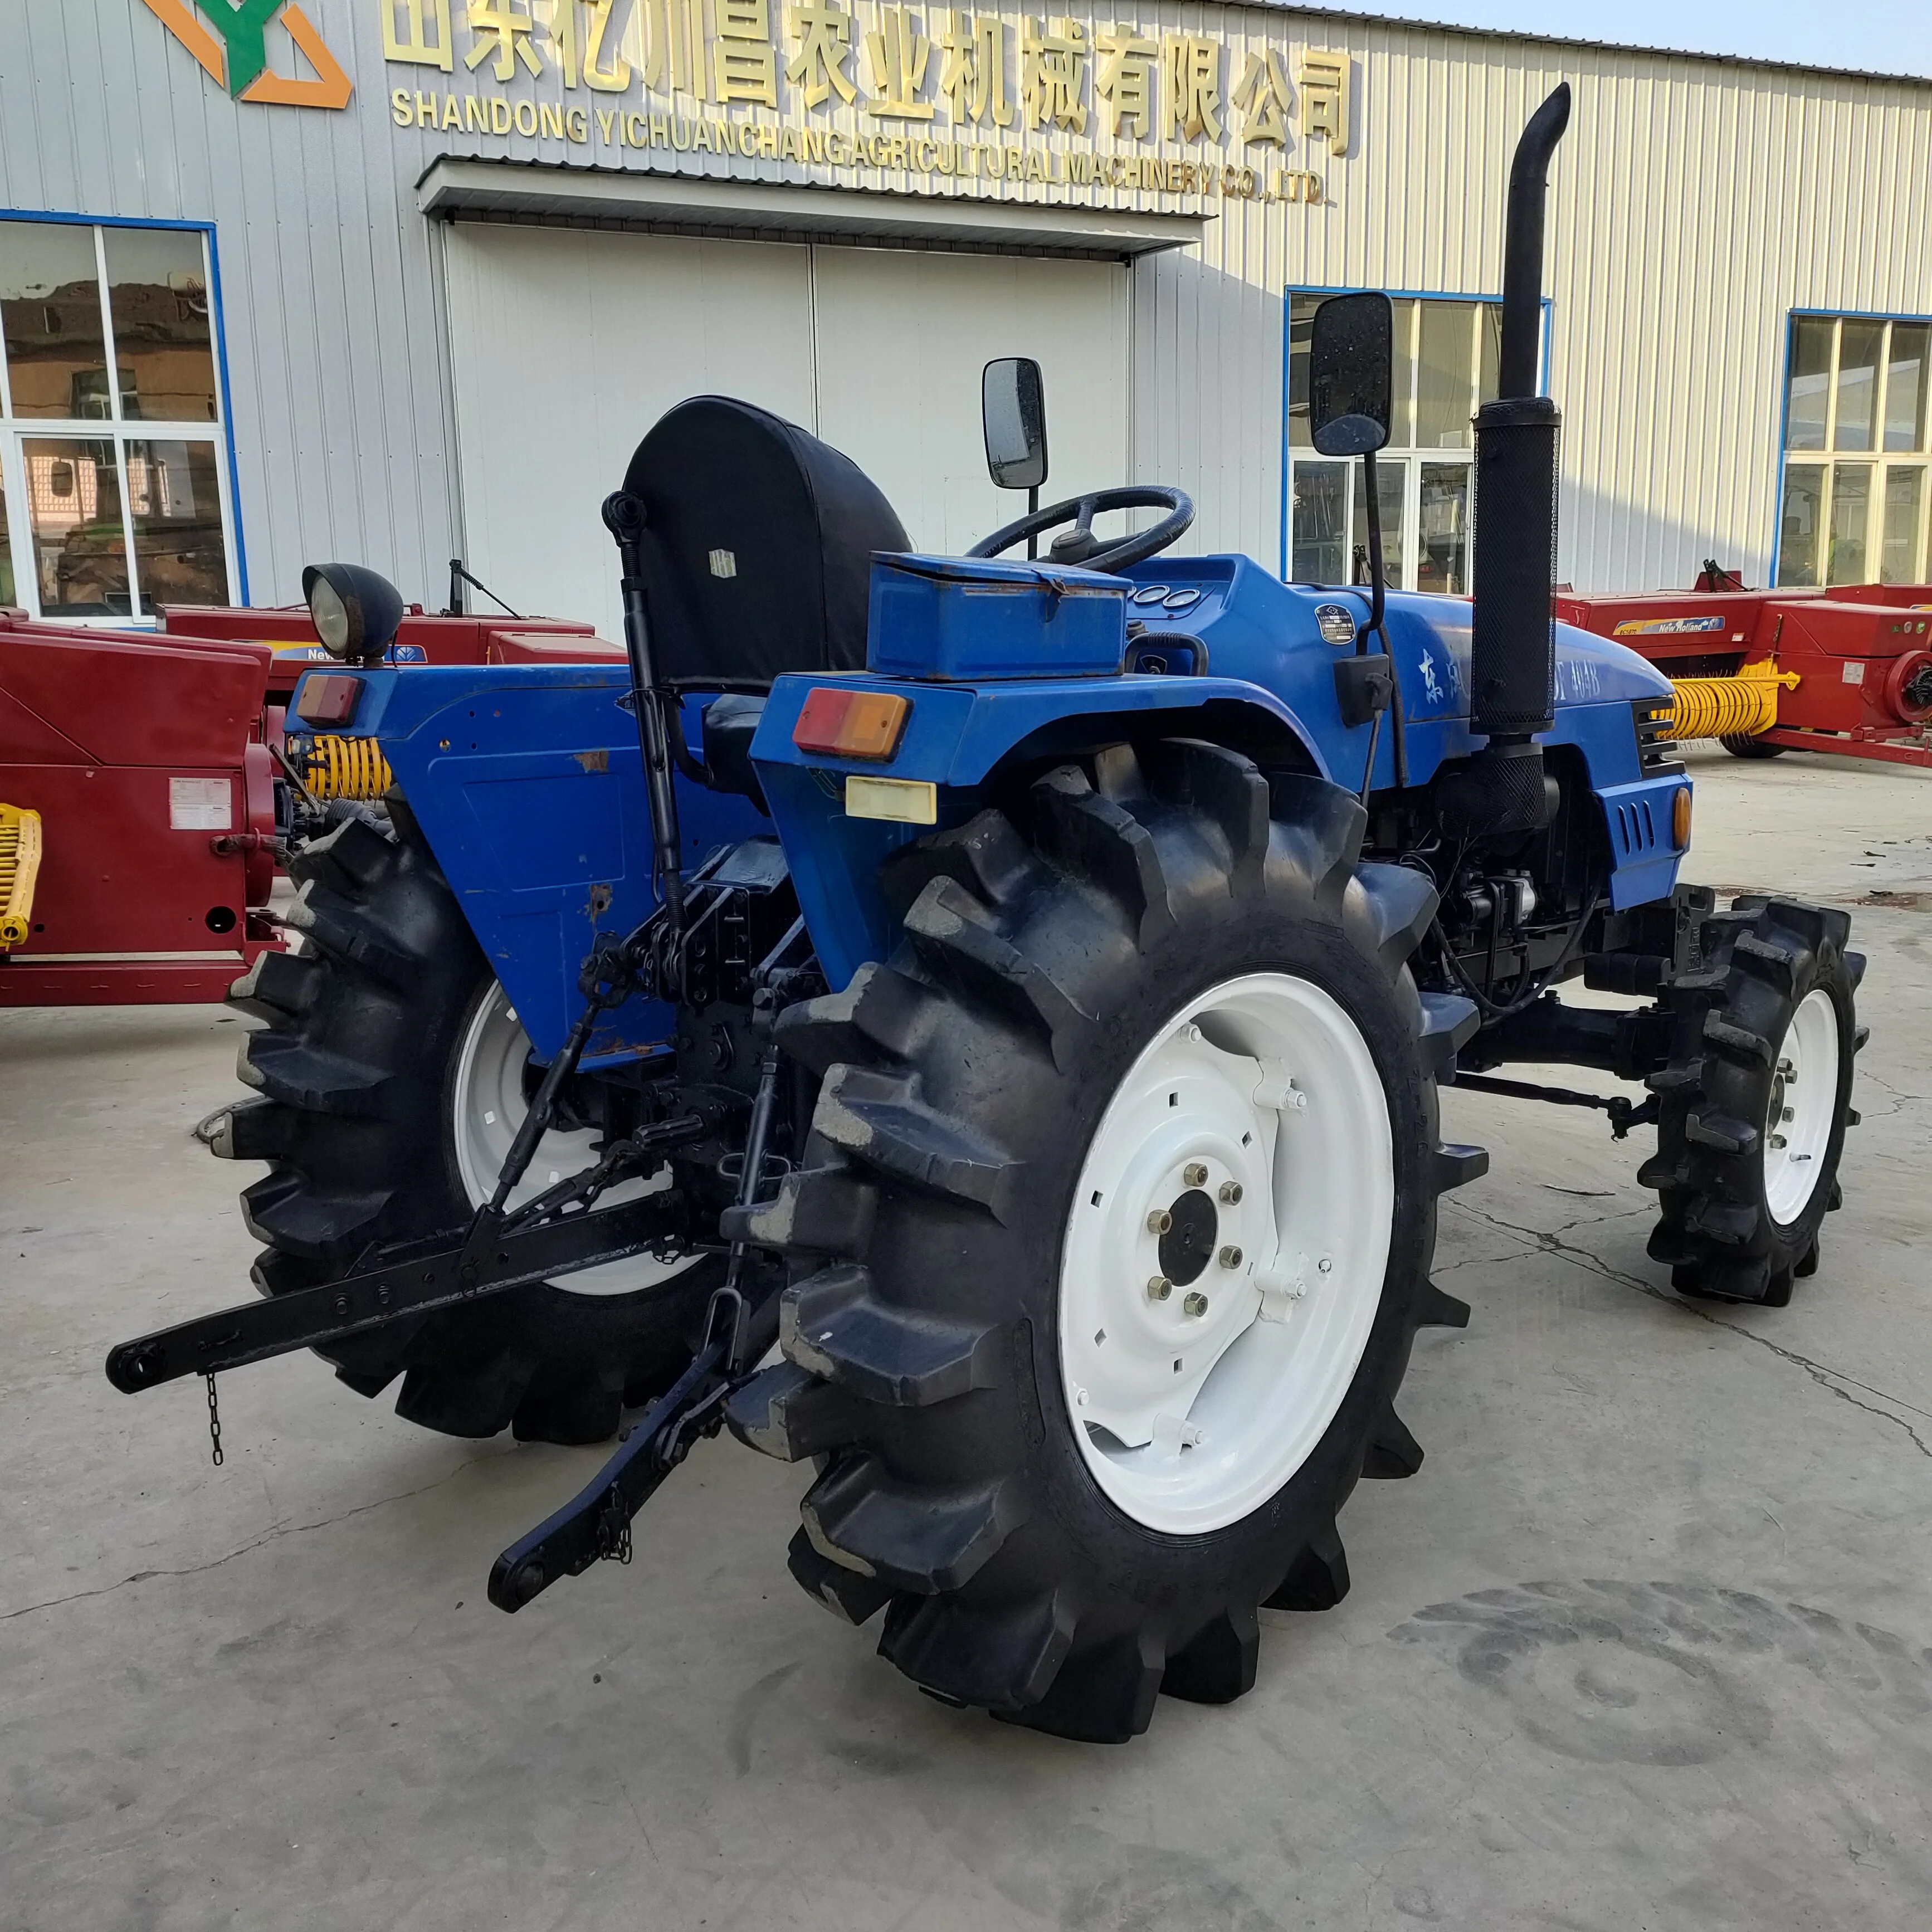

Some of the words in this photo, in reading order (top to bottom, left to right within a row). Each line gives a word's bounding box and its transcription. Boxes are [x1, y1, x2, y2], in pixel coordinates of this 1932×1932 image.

[381, 0, 1350, 155] 山东亿川昌农业机械有限公司
[391, 87, 587, 143] SHANDONG
[1062, 149, 1215, 196] MACHINERY
[1659, 622, 1675, 633] New
